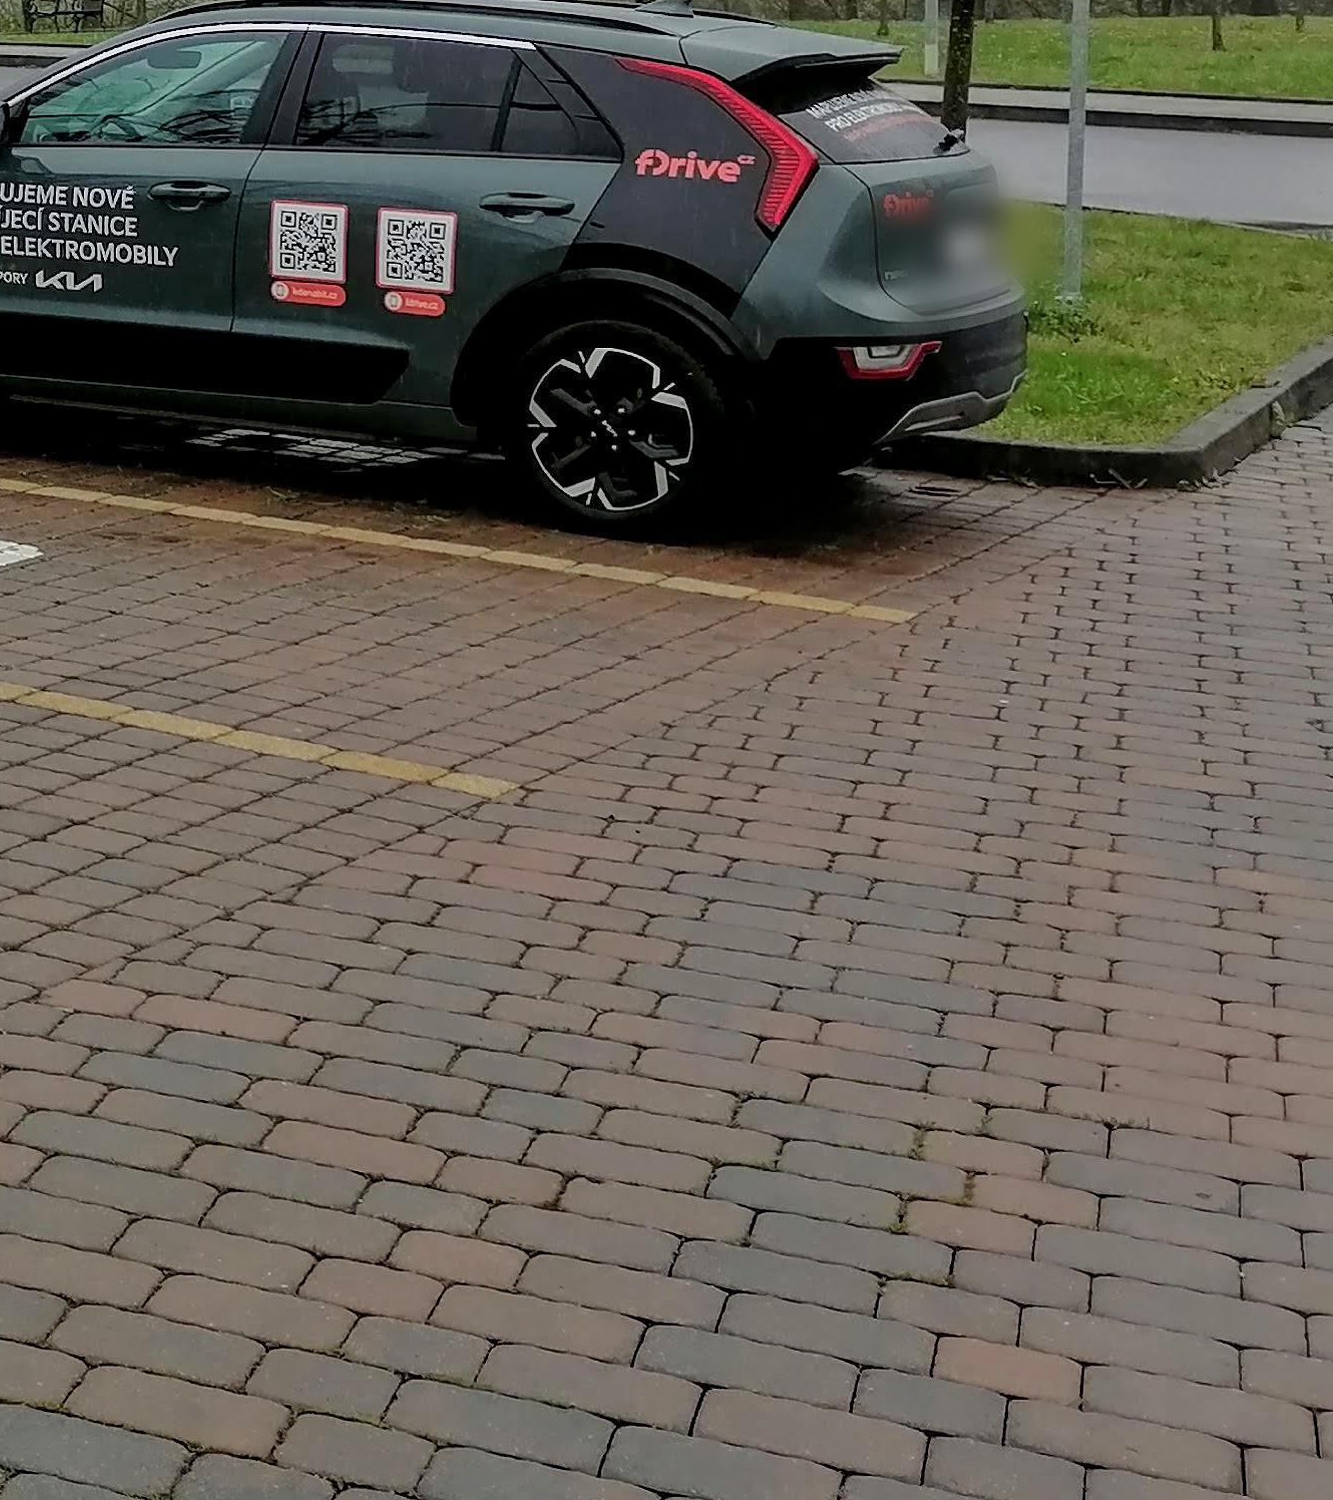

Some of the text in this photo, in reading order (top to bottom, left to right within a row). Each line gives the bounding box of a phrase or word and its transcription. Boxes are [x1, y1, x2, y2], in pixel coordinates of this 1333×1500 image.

[72, 186, 134, 210] NOVÉ
[48, 212, 138, 237] STANICE
[0, 236, 178, 267] ELEKTROMOBILY
